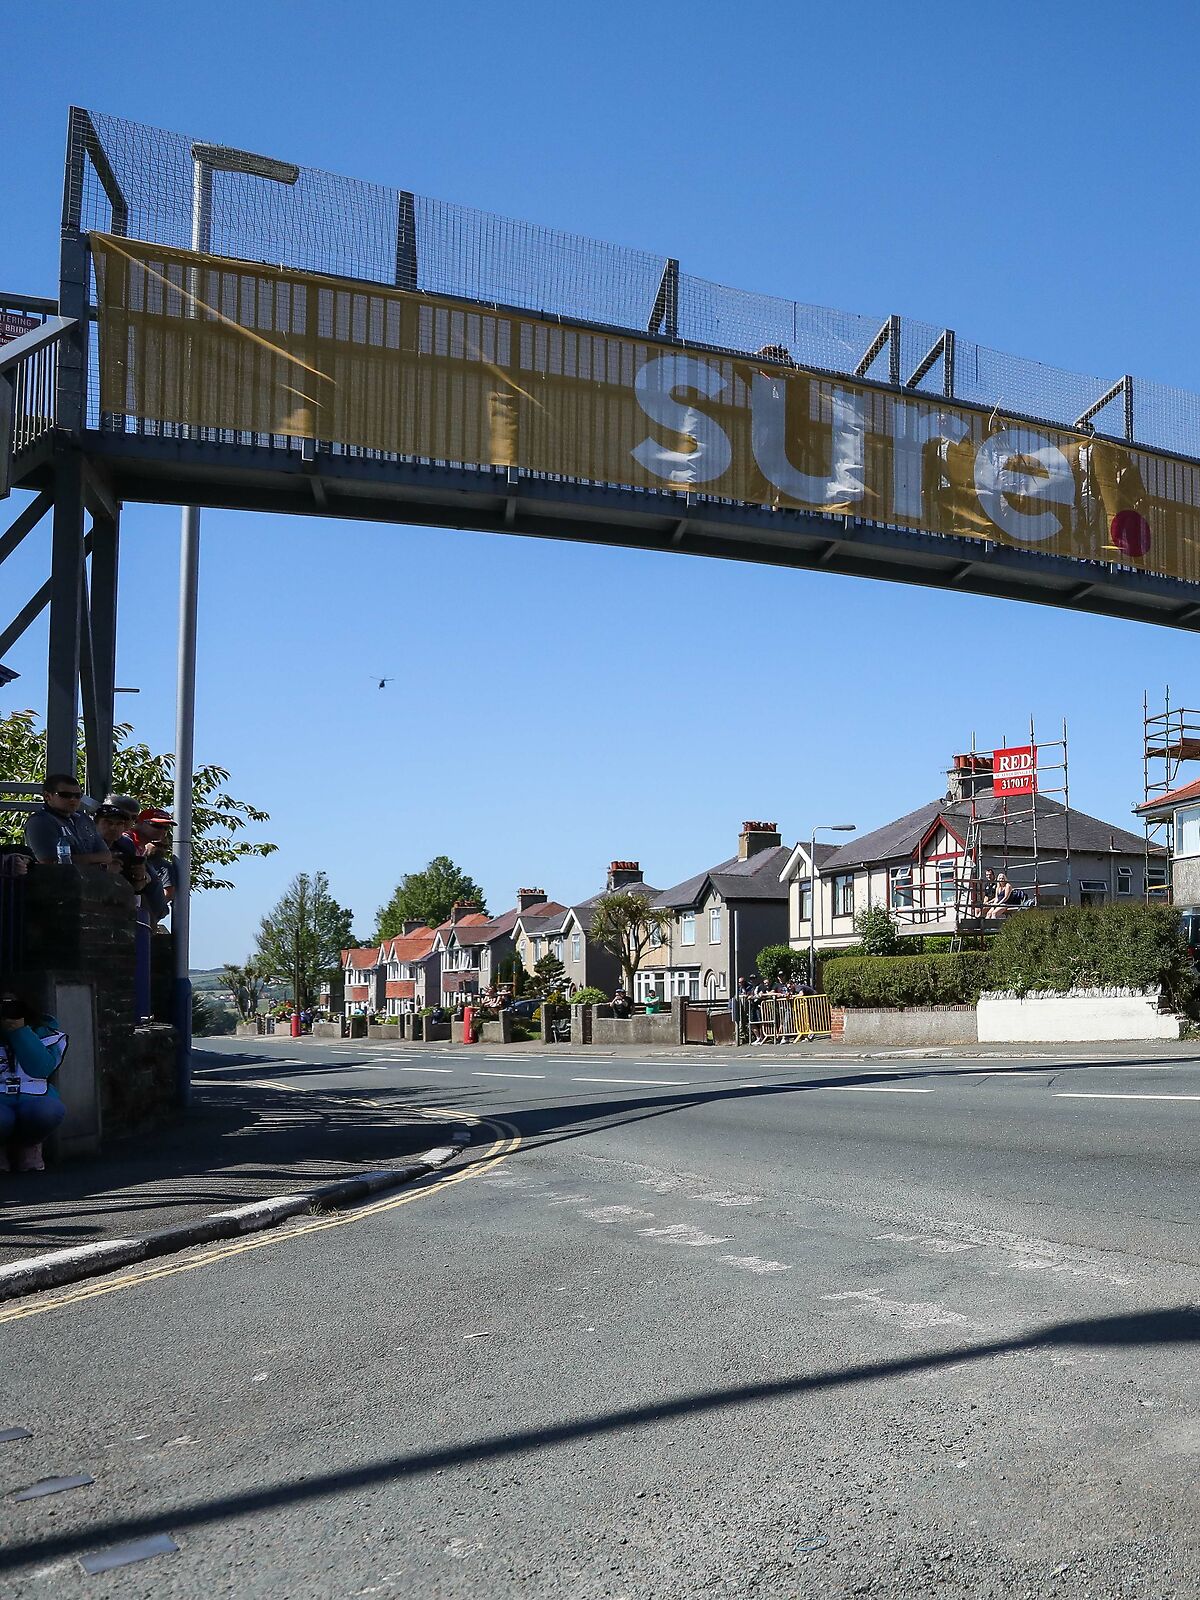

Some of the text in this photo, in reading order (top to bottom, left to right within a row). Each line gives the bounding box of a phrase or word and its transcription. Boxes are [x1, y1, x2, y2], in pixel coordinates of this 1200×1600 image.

[0, 314, 32, 327] TERING
[5, 324, 32, 334] BRIDG
[999, 754, 1032, 771] RED
[1001, 777, 1029, 790] 317017
